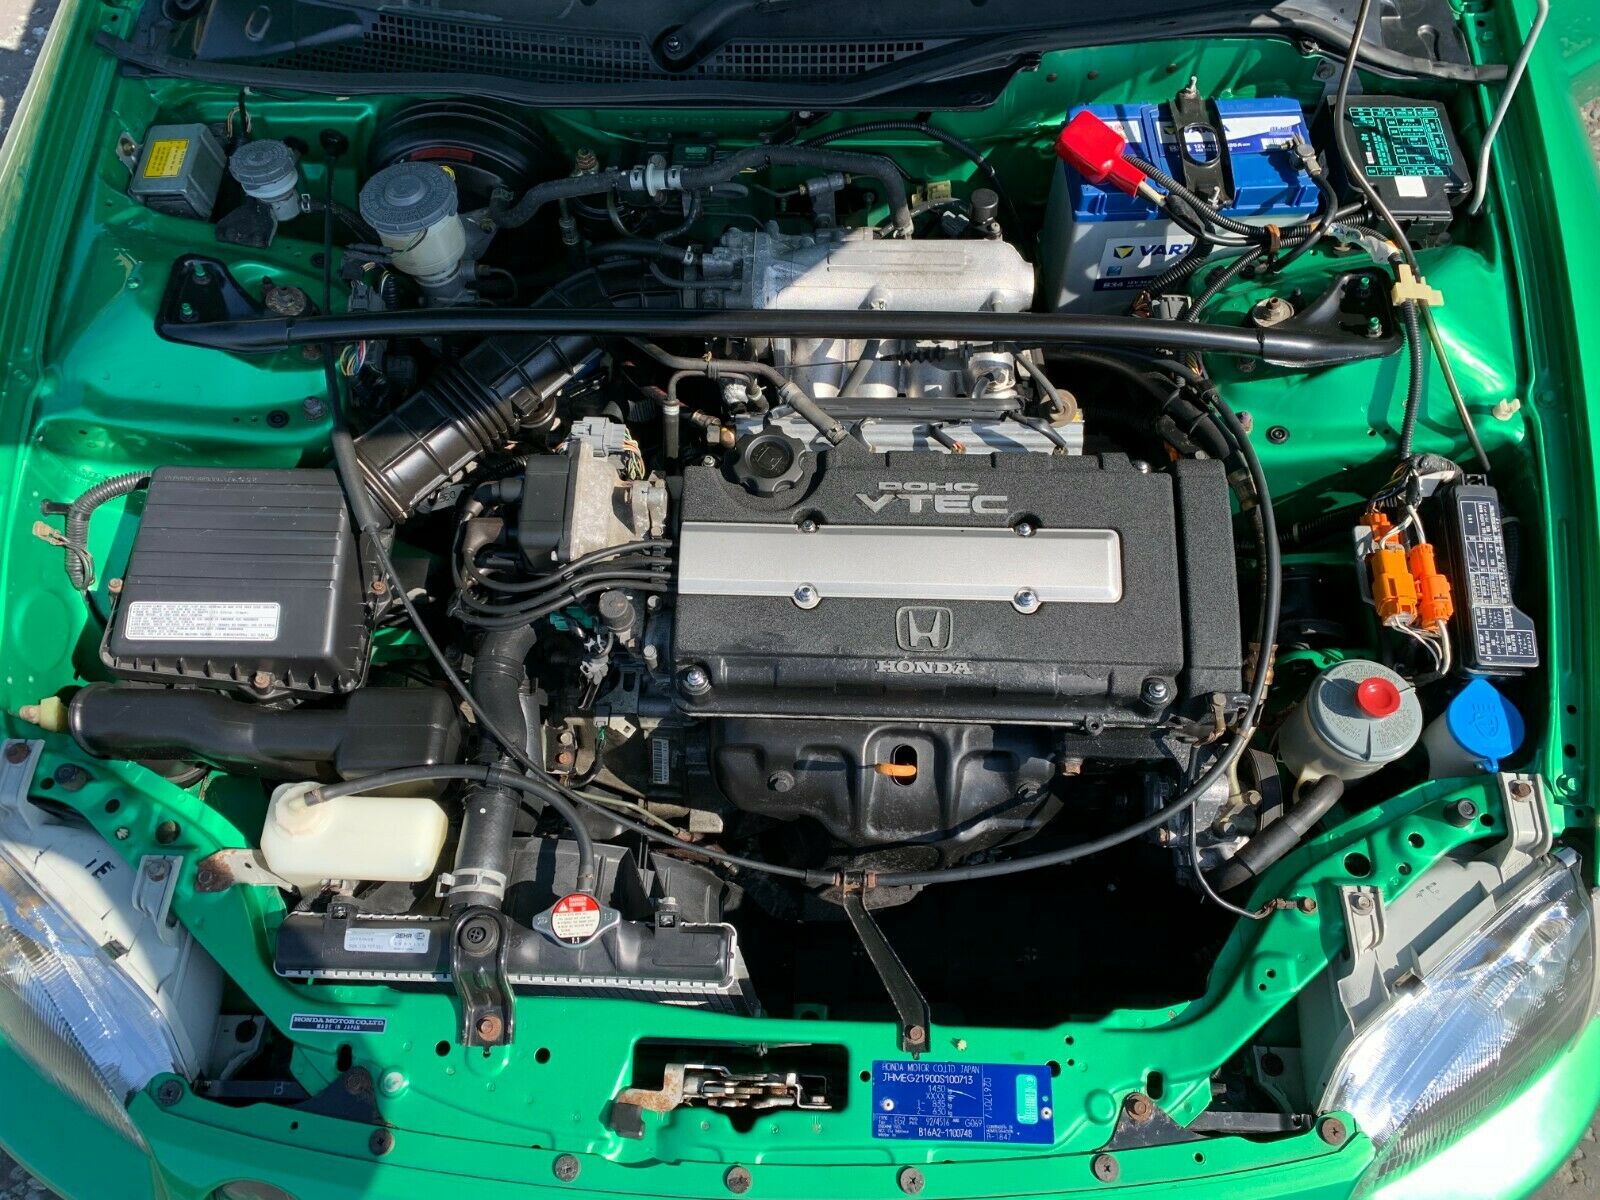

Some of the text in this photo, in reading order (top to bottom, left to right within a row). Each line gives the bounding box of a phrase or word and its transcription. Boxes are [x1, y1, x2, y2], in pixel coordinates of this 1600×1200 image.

[1140, 244, 1193, 256] VART
[878, 481, 979, 492] DOHC
[856, 494, 1008, 514] VTEC
[876, 660, 973, 675] HONDA
[882, 1063, 904, 1071] HONDA
[907, 1063, 929, 1072] MOTOR
[960, 1065, 980, 1074] JAPAN
